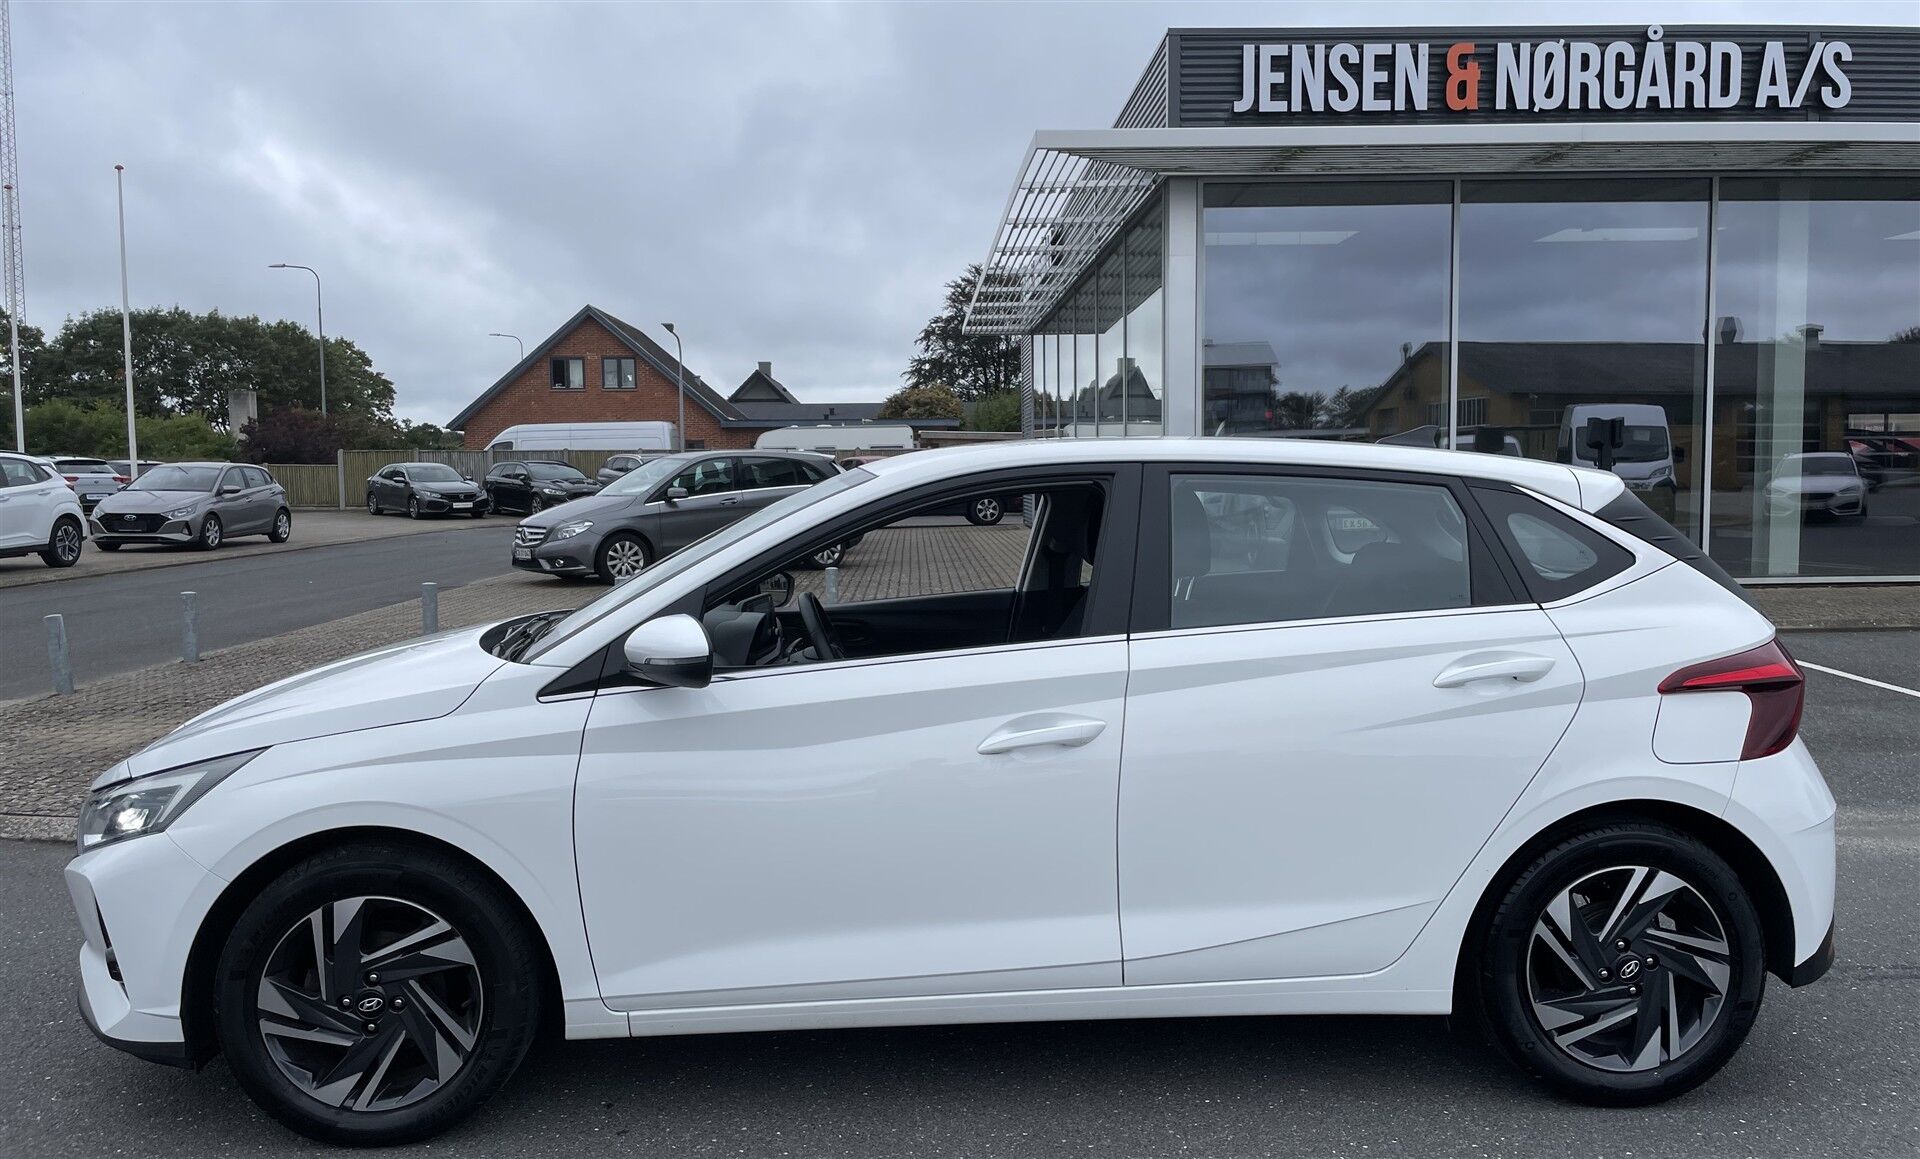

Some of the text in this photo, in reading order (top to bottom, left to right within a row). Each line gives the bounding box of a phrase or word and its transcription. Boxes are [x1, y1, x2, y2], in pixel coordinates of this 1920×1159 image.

[1234, 24, 1853, 112] JENSEN & NØRGÅRD A/S
